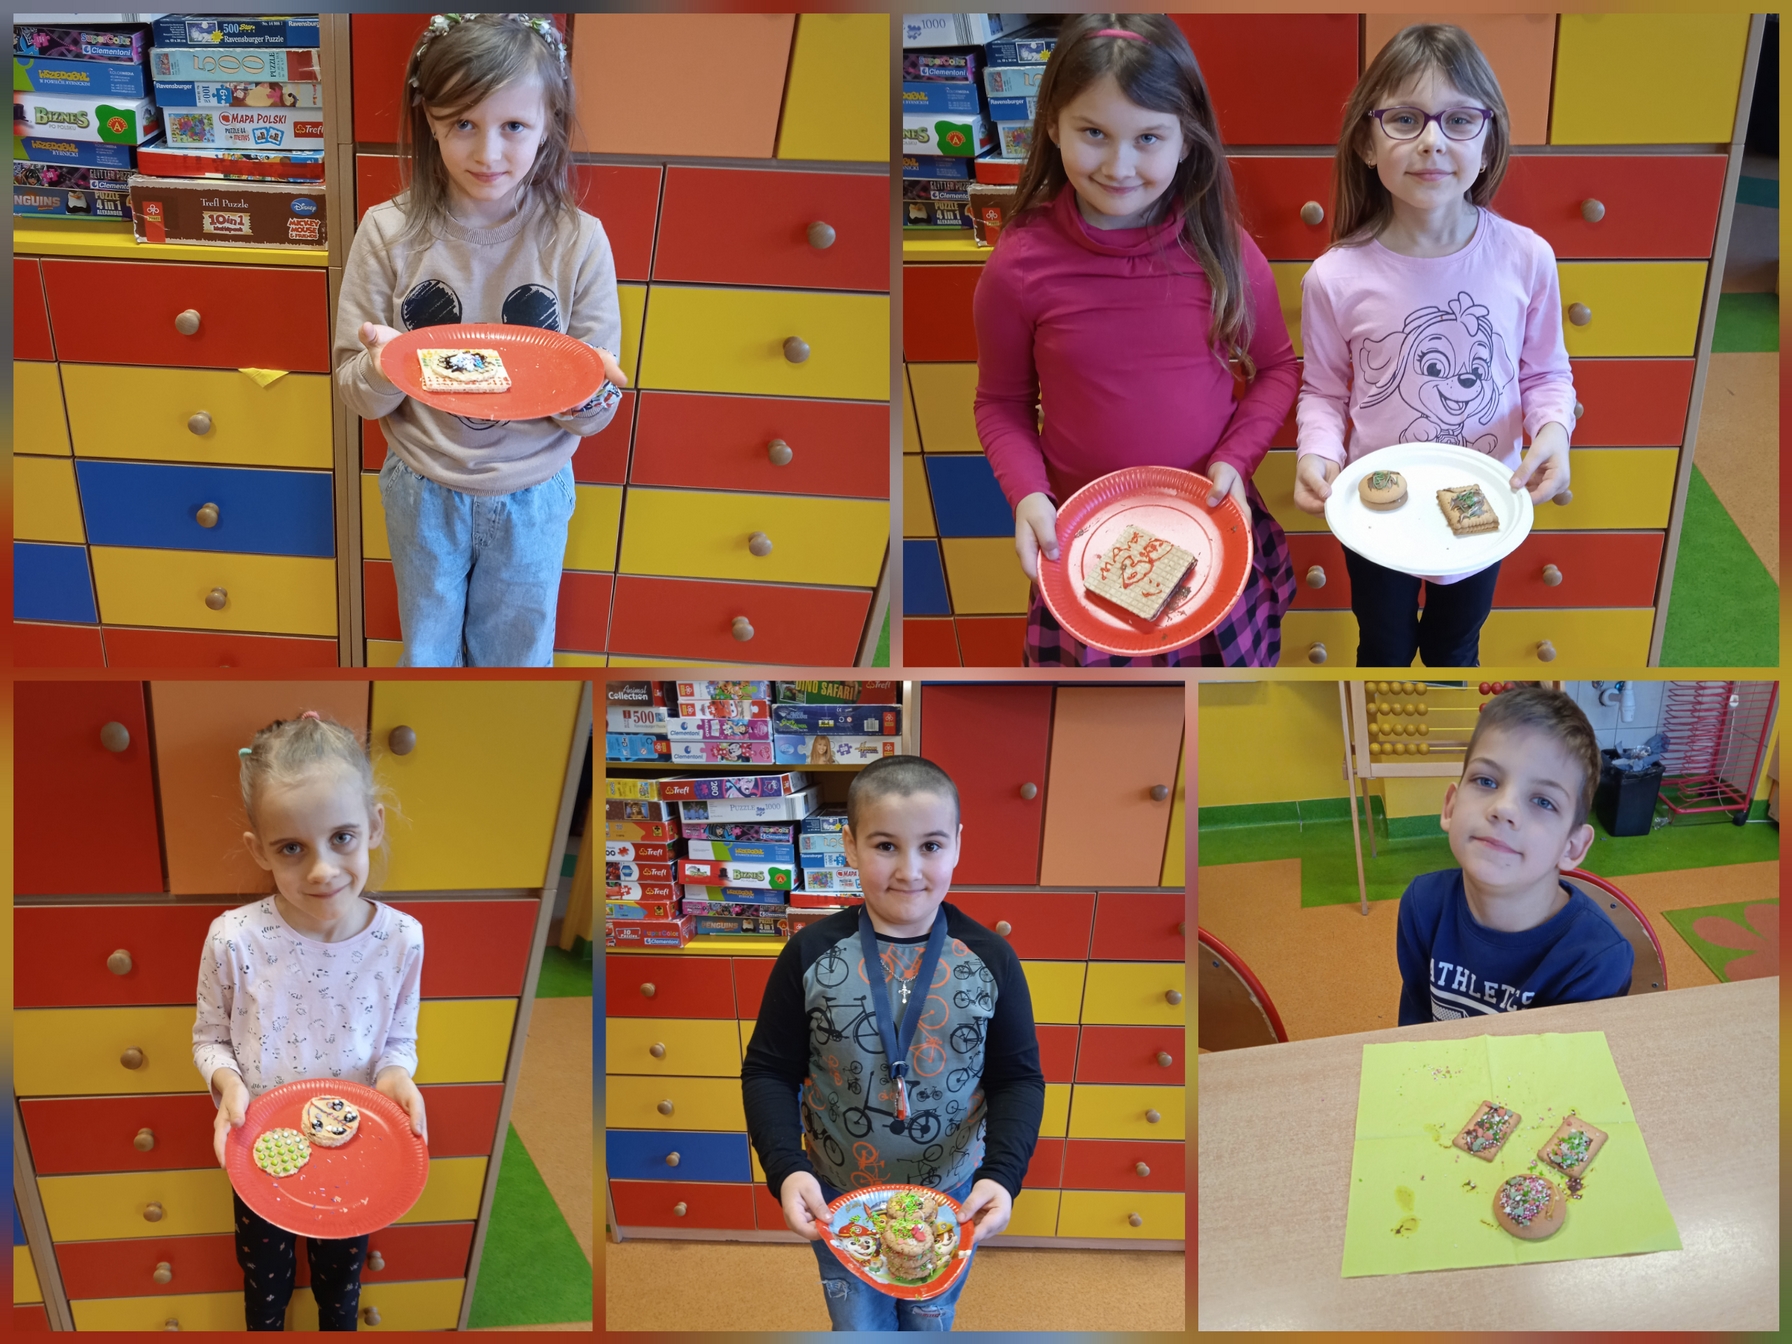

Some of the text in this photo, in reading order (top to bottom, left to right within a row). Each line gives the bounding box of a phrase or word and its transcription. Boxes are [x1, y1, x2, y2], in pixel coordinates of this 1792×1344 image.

[223, 23, 239, 33] 500
[922, 19, 946, 29] 1000
[224, 36, 264, 44] Ravensburger
[91, 47, 131, 56] Clementoni
[193, 54, 265, 74] 500
[928, 68, 966, 76] Clementoni
[34, 106, 90, 128] BIZNES
[231, 113, 287, 125] MAPA POLSKI
[89, 169, 115, 180] GLITTER
[95, 191, 120, 200] PUZZLE
[96, 199, 103, 209] 4
[104, 200, 115, 210] in
[200, 198, 249, 209] Trefl Puzzle
[293, 203, 317, 212] Disney
[934, 202, 959, 210] PUZZLE
[936, 210, 944, 219] 4
[944, 210, 955, 219] in
[289, 219, 320, 227] MICKEY
[623, 684, 648, 694] Animal
[874, 680, 891, 689] Trefl
[795, 680, 854, 700] DINO SAFARI
[608, 691, 649, 700] Collection
[633, 710, 655, 724] 500
[673, 786, 690, 795] Trefl
[710, 781, 719, 796] 260
[730, 804, 756, 812] PUZZLE
[647, 848, 663, 857] Trefl
[651, 868, 667, 877] Trefl
[733, 869, 765, 882] BIZNES
[654, 887, 669, 896] Trefl
[701, 921, 739, 929] PENGUINS
